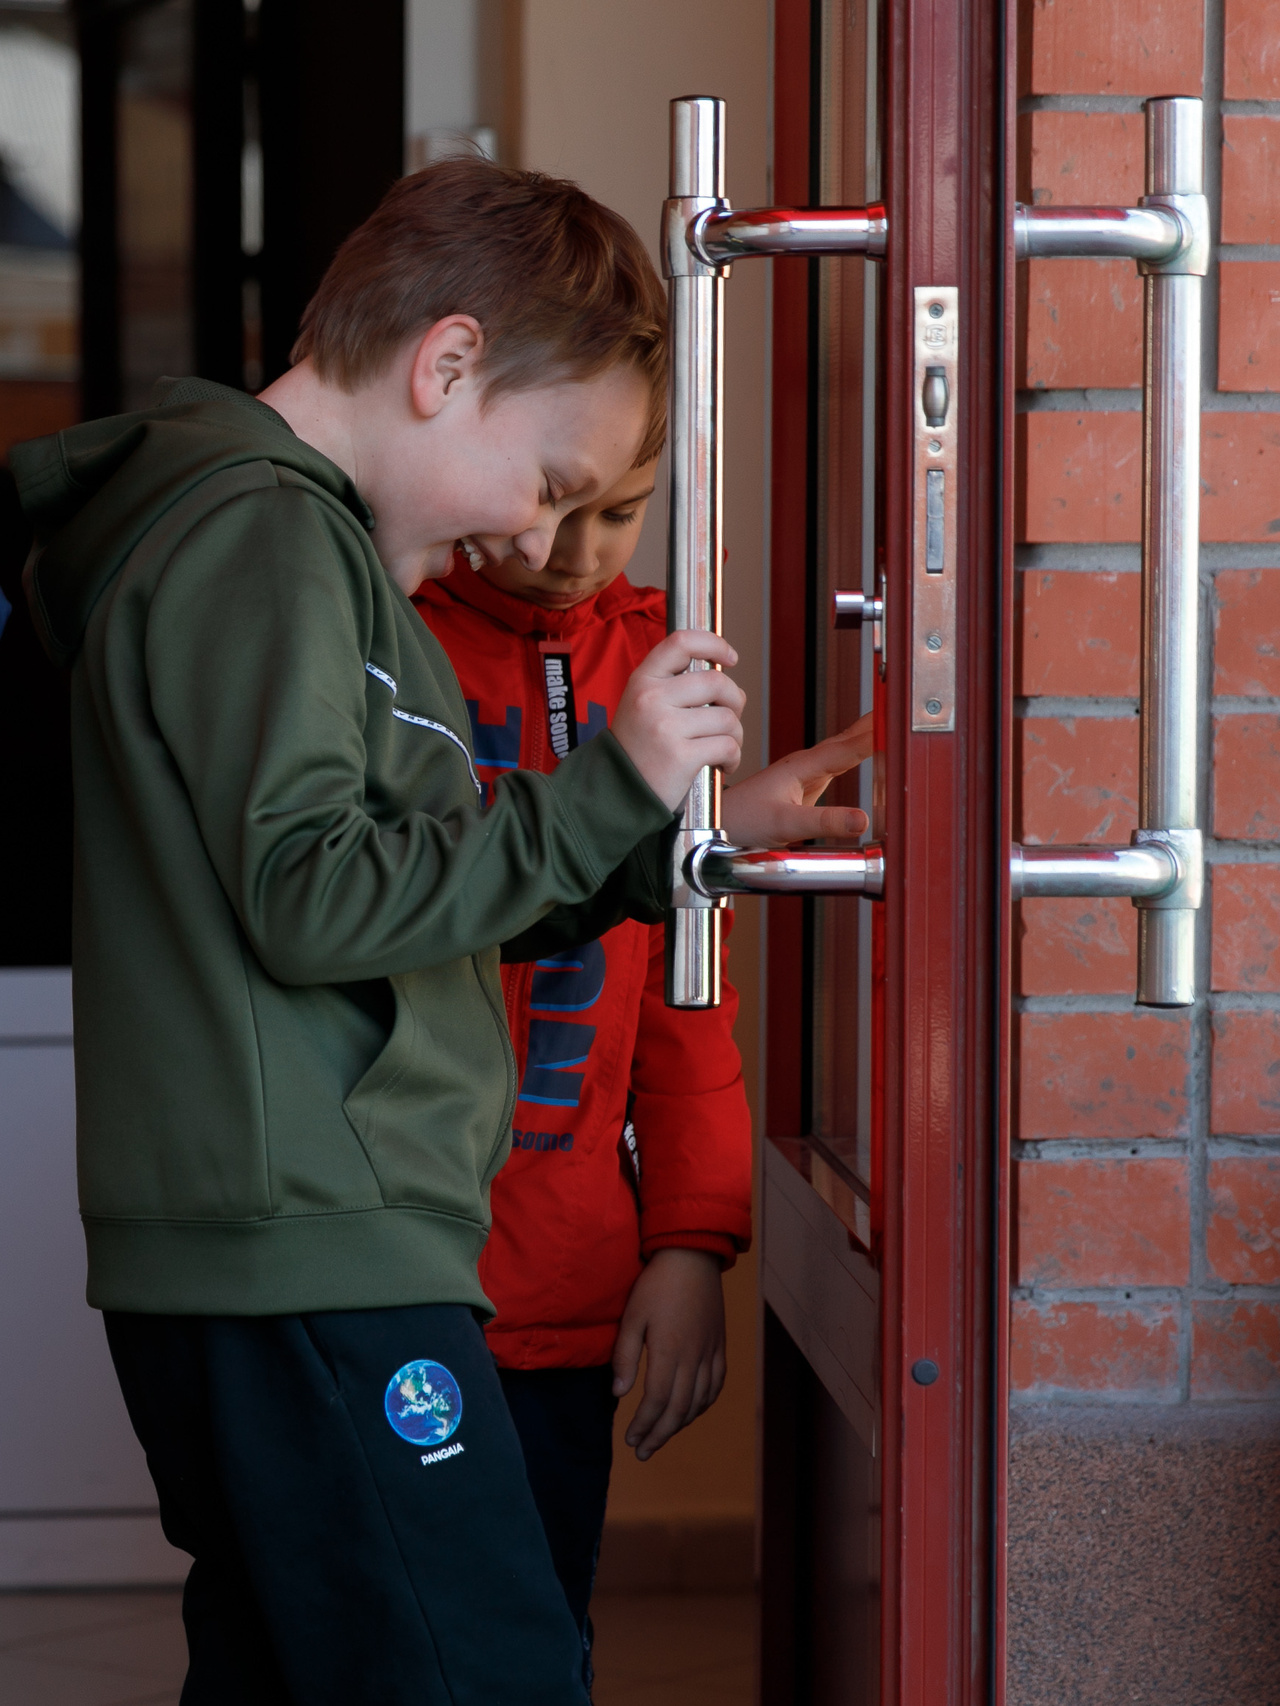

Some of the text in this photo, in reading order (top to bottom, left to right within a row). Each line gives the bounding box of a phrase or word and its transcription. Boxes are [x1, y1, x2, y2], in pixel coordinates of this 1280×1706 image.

[545, 659, 568, 709] make
[512, 1129, 574, 1151] some
[421, 1442, 464, 1466] PANGAIA
